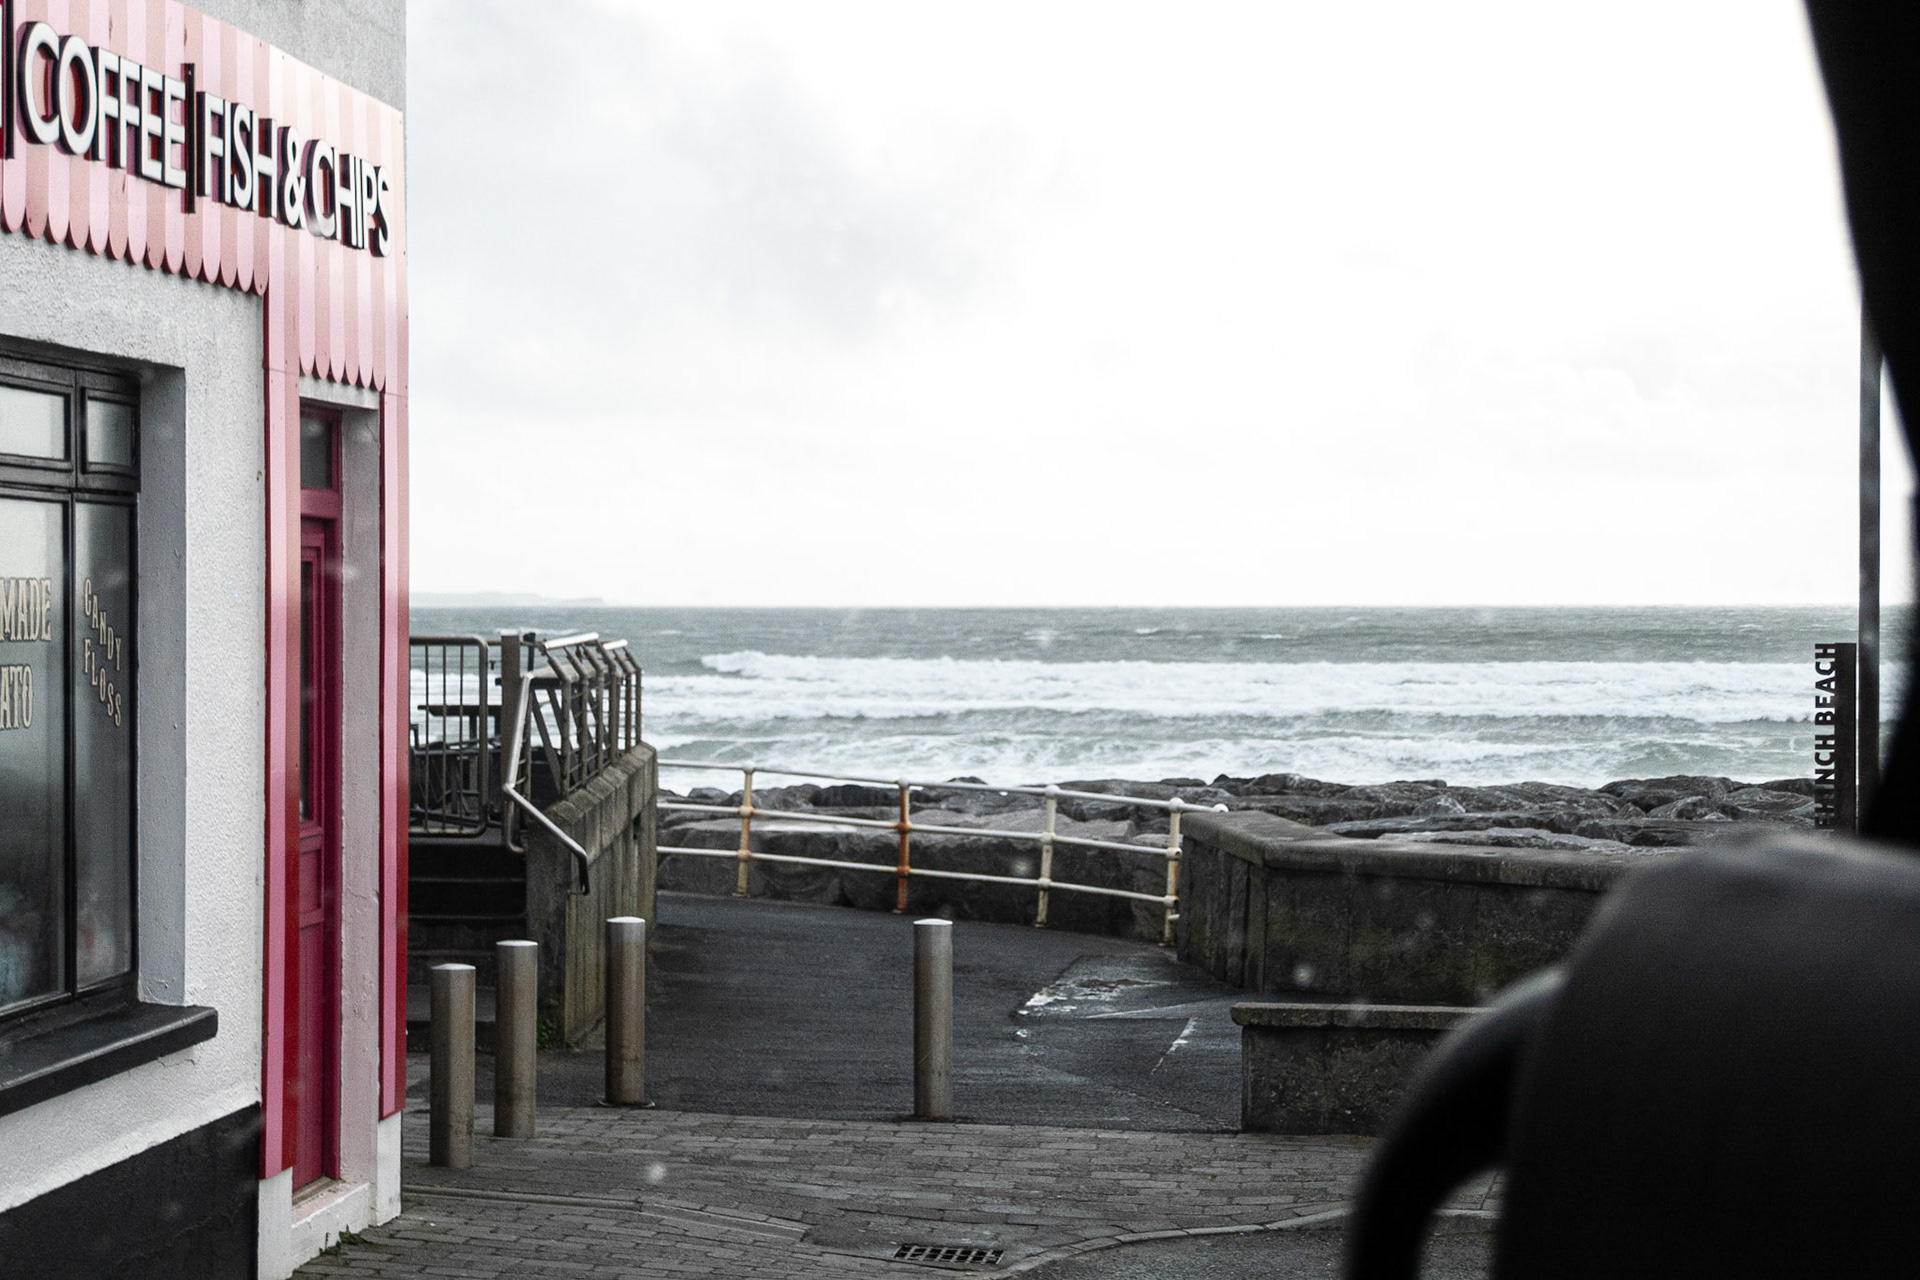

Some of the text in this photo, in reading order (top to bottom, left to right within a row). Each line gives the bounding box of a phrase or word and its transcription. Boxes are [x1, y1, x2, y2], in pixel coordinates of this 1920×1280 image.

[20, 21, 187, 189] COFFEE
[197, 91, 278, 219] FISH
[307, 139, 391, 257] CHIPS
[83, 638, 122, 727] FLOSS
[1815, 643, 1836, 832] EHINCH BEACH
